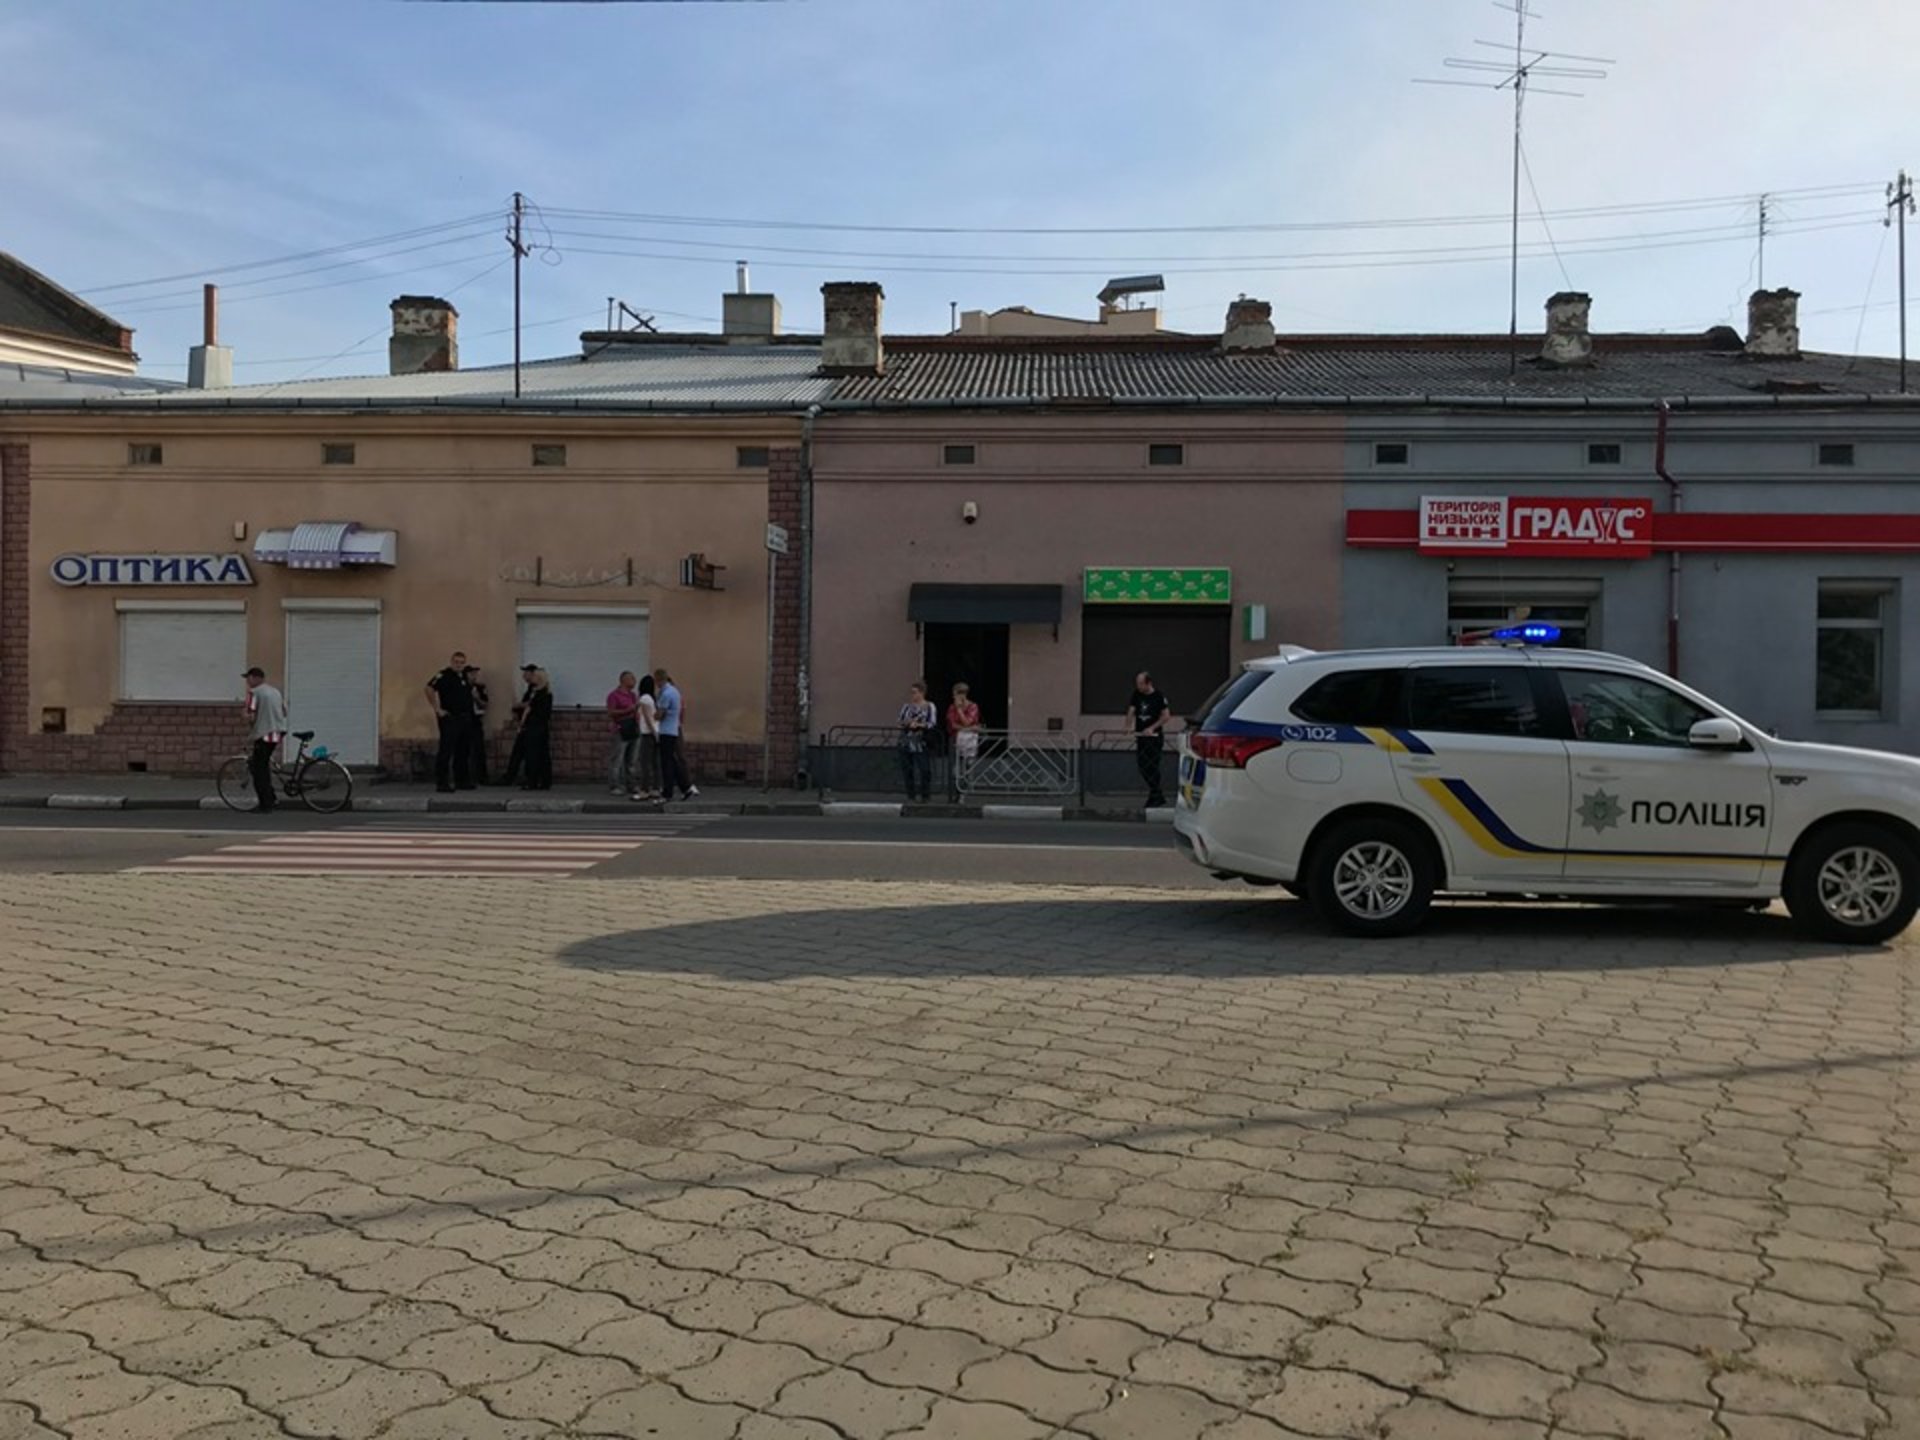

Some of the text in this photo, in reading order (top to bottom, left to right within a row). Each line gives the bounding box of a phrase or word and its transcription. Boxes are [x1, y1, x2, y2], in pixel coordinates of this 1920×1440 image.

[1428, 502, 1500, 512] ТЕРИТОРІЯ
[1428, 514, 1499, 525] НИЗЬКИХ
[54, 557, 247, 582] ОПТИКА
[1305, 727, 1337, 741] 102
[1631, 801, 1766, 828] ПОЛІЦІЯ
